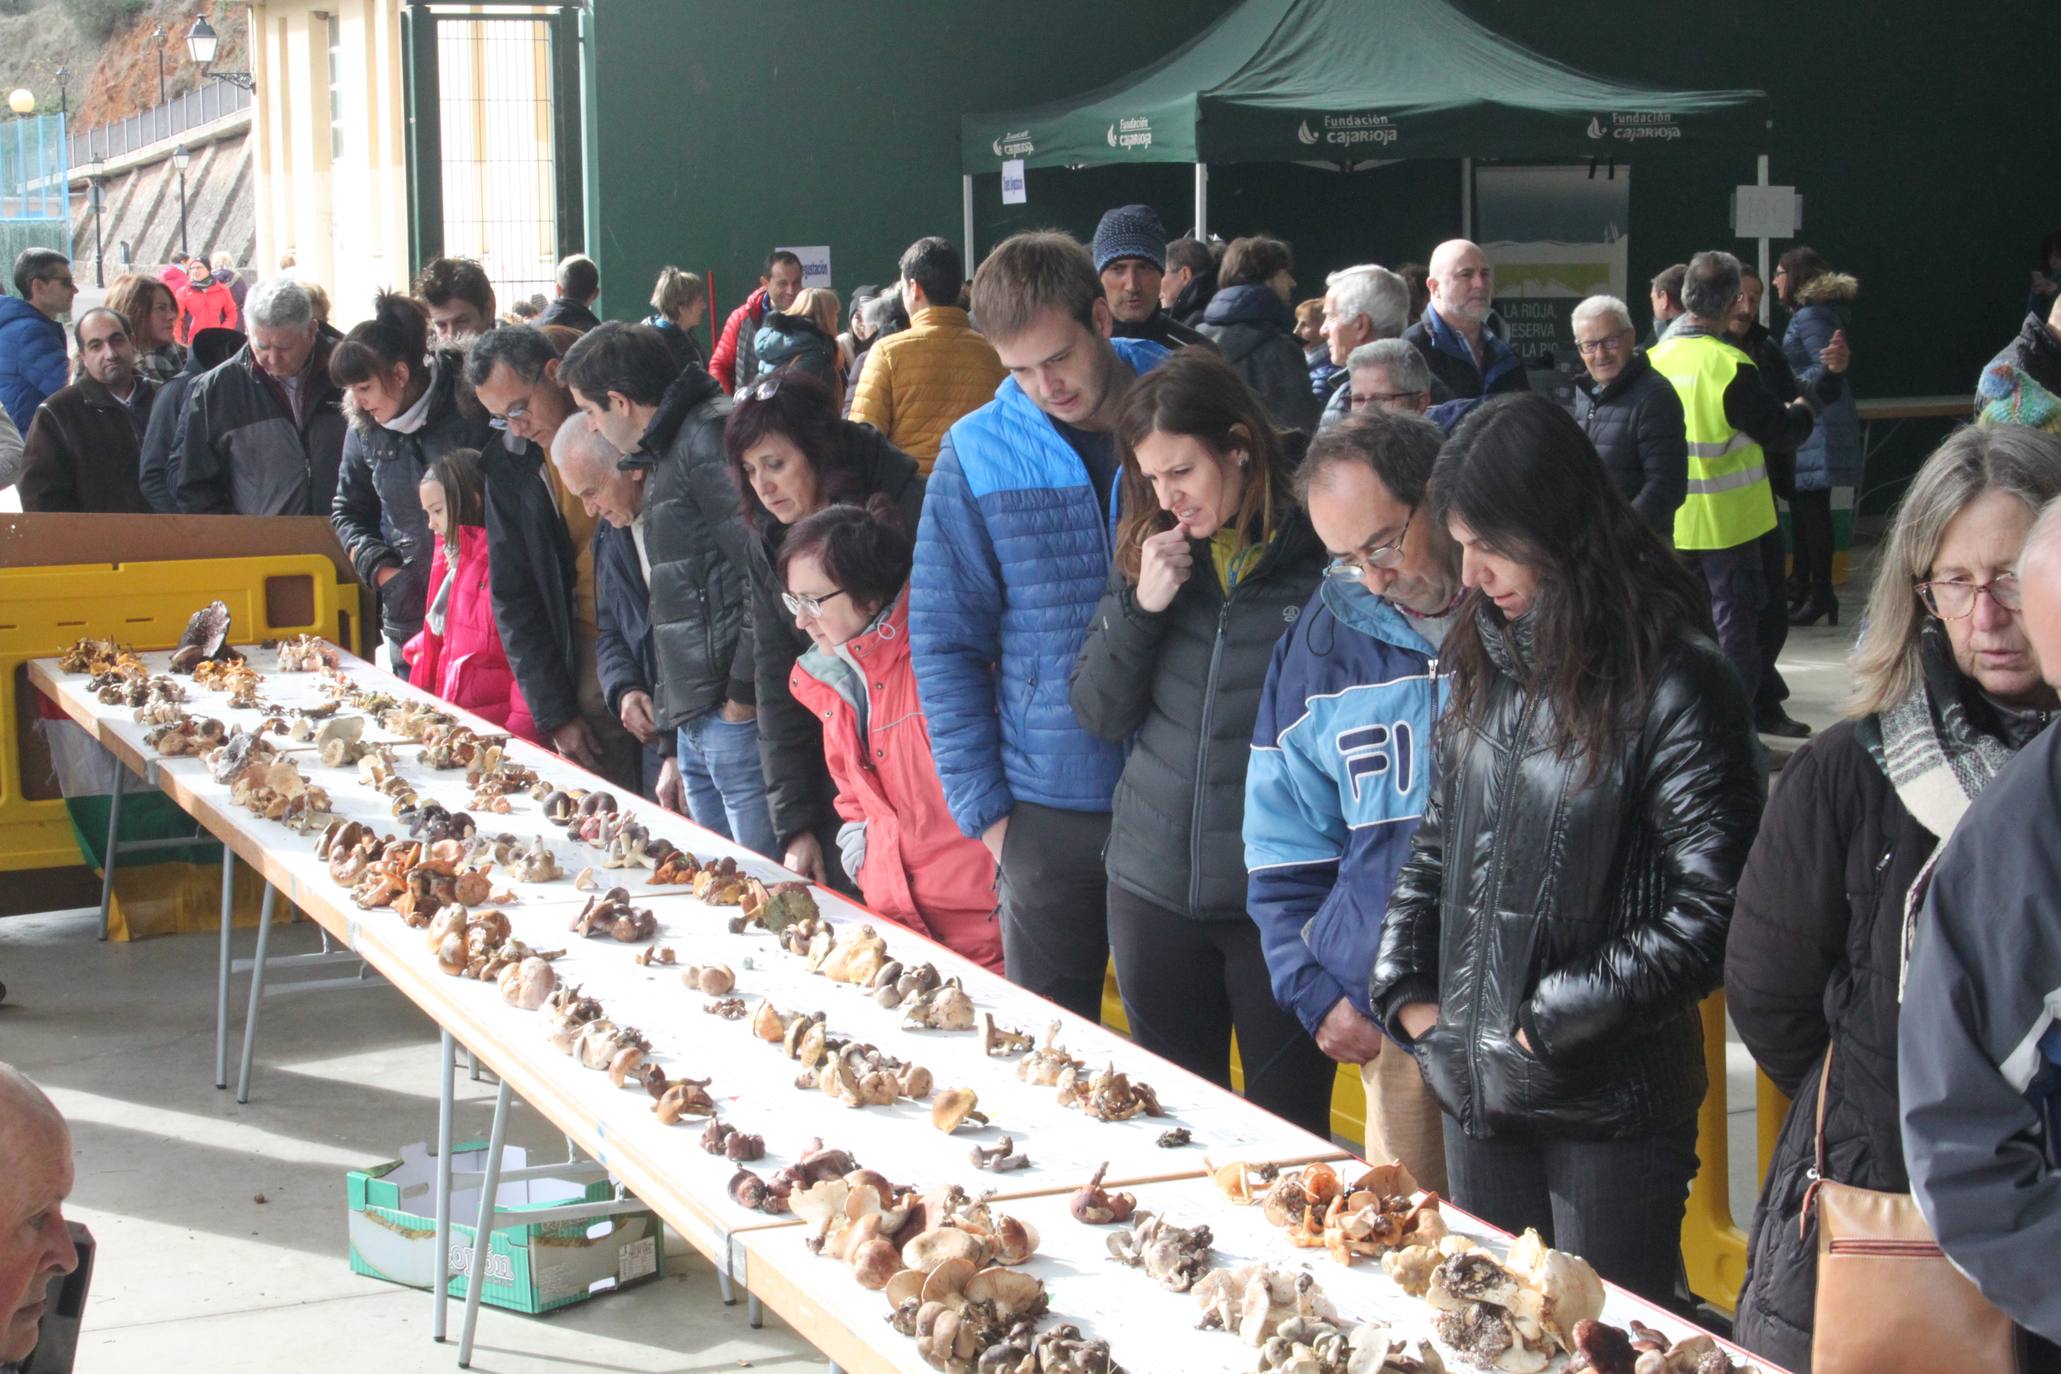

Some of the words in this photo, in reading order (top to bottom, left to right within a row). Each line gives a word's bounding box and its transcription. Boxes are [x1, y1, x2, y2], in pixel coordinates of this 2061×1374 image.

[1324, 114, 1389, 127] Fundación
[1612, 112, 1672, 123] Fundación
[1503, 303, 1518, 318] LA
[1510, 323, 1556, 338] ESERVA
[1521, 342, 1536, 358] LA
